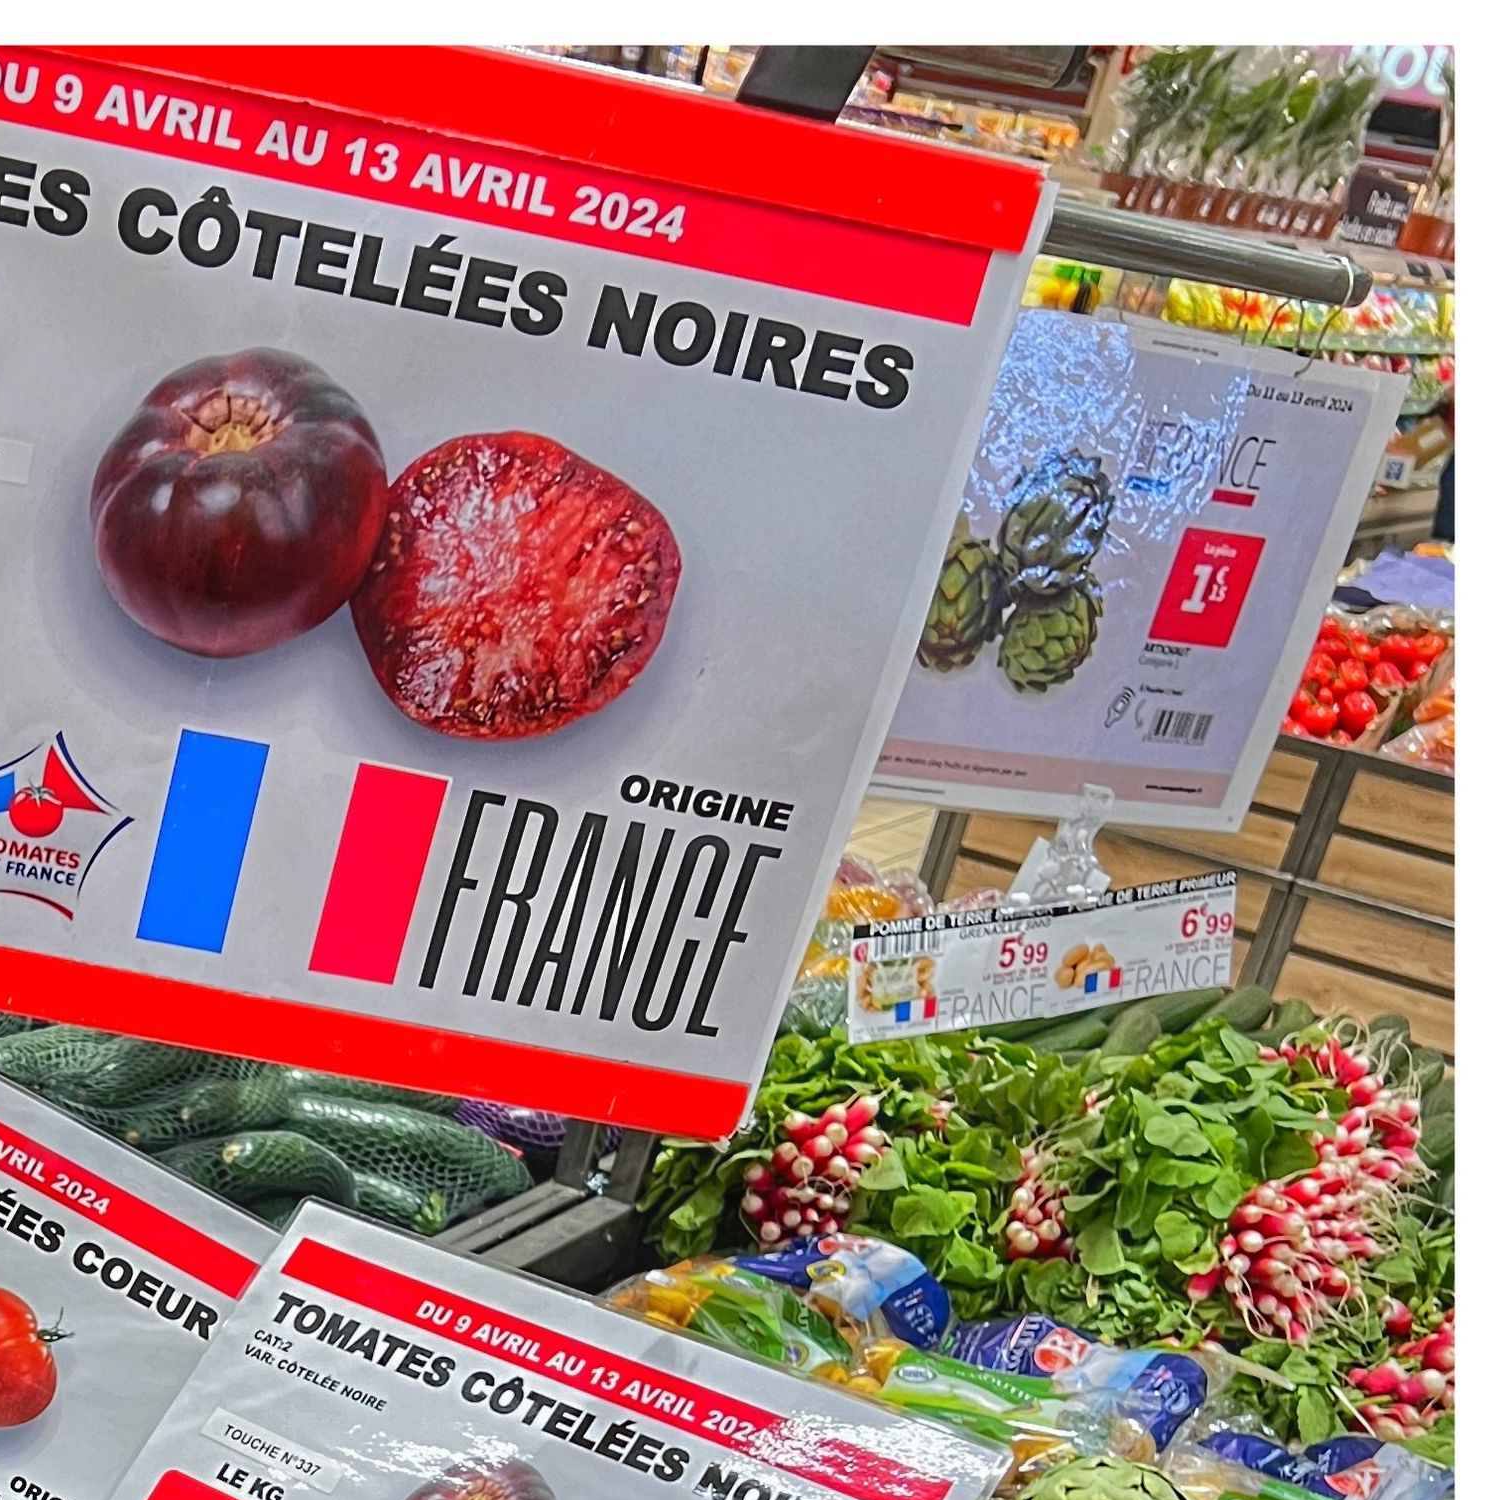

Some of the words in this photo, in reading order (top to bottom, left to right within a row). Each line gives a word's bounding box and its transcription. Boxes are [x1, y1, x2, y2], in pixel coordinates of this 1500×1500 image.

[54, 75, 83, 112] 9
[95, 90, 242, 149] AVRIL
[255, 121, 328, 166] AU
[344, 139, 398, 181] 13
[410, 154, 556, 215] AVRIL
[569, 185, 688, 243] 2024
[117, 187, 568, 336] CÔTELÉES
[588, 285, 914, 410] NOIRES
[1328, 397, 1353, 412] 2024
[620, 775, 794, 831] ORIGINE
[5, 861, 77, 887] FRANCE
[1137, 879, 1177, 900] TERRE
[419, 789, 782, 1037] FRANCE
[870, 920, 923, 936] POMME
[925, 917, 945, 929] DE
[950, 911, 993, 927] TERRE
[1120, 953, 1229, 998] FRANCE
[937, 984, 1046, 1029] FRANCE
[51, 1172, 113, 1216] 2024
[73, 1241, 220, 1342] COEUR
[253, 1328, 294, 1353] CAT:2
[415, 1300, 451, 1328] DU
[455, 1315, 471, 1334] 9
[472, 1324, 541, 1362] AVRIL
[548, 1350, 586, 1377] AU
[588, 1366, 619, 1392] 13
[620, 1378, 695, 1423] AVRIL
[244, 1344, 275, 1366] VAR:
[277, 1356, 341, 1394] CÔTELÉE
[341, 1383, 387, 1412] NOIRE
[273, 1292, 456, 1388] TOMATES
[461, 1370, 690, 1484] CÔTELÉES
[216, 1462, 245, 1489] LE
[223, 1424, 280, 1460] TOUCHE
[280, 1449, 322, 1478] N°337
